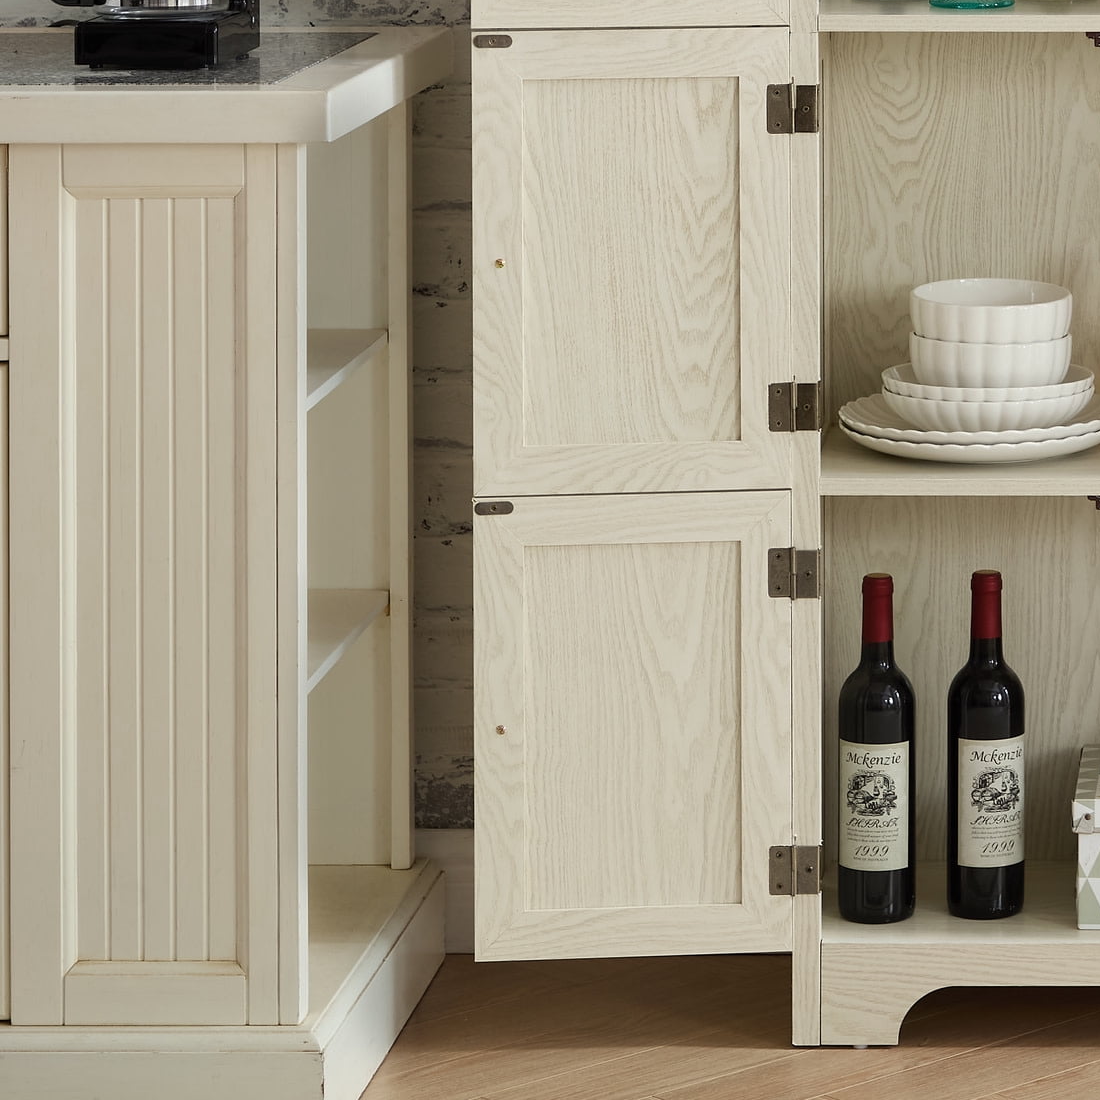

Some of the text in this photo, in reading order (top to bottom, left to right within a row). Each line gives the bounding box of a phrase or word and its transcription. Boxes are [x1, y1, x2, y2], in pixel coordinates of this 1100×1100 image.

[846, 751, 902, 769] Mckenzie
[854, 845, 890, 857] 1999
[982, 840, 1015, 854] 1999
